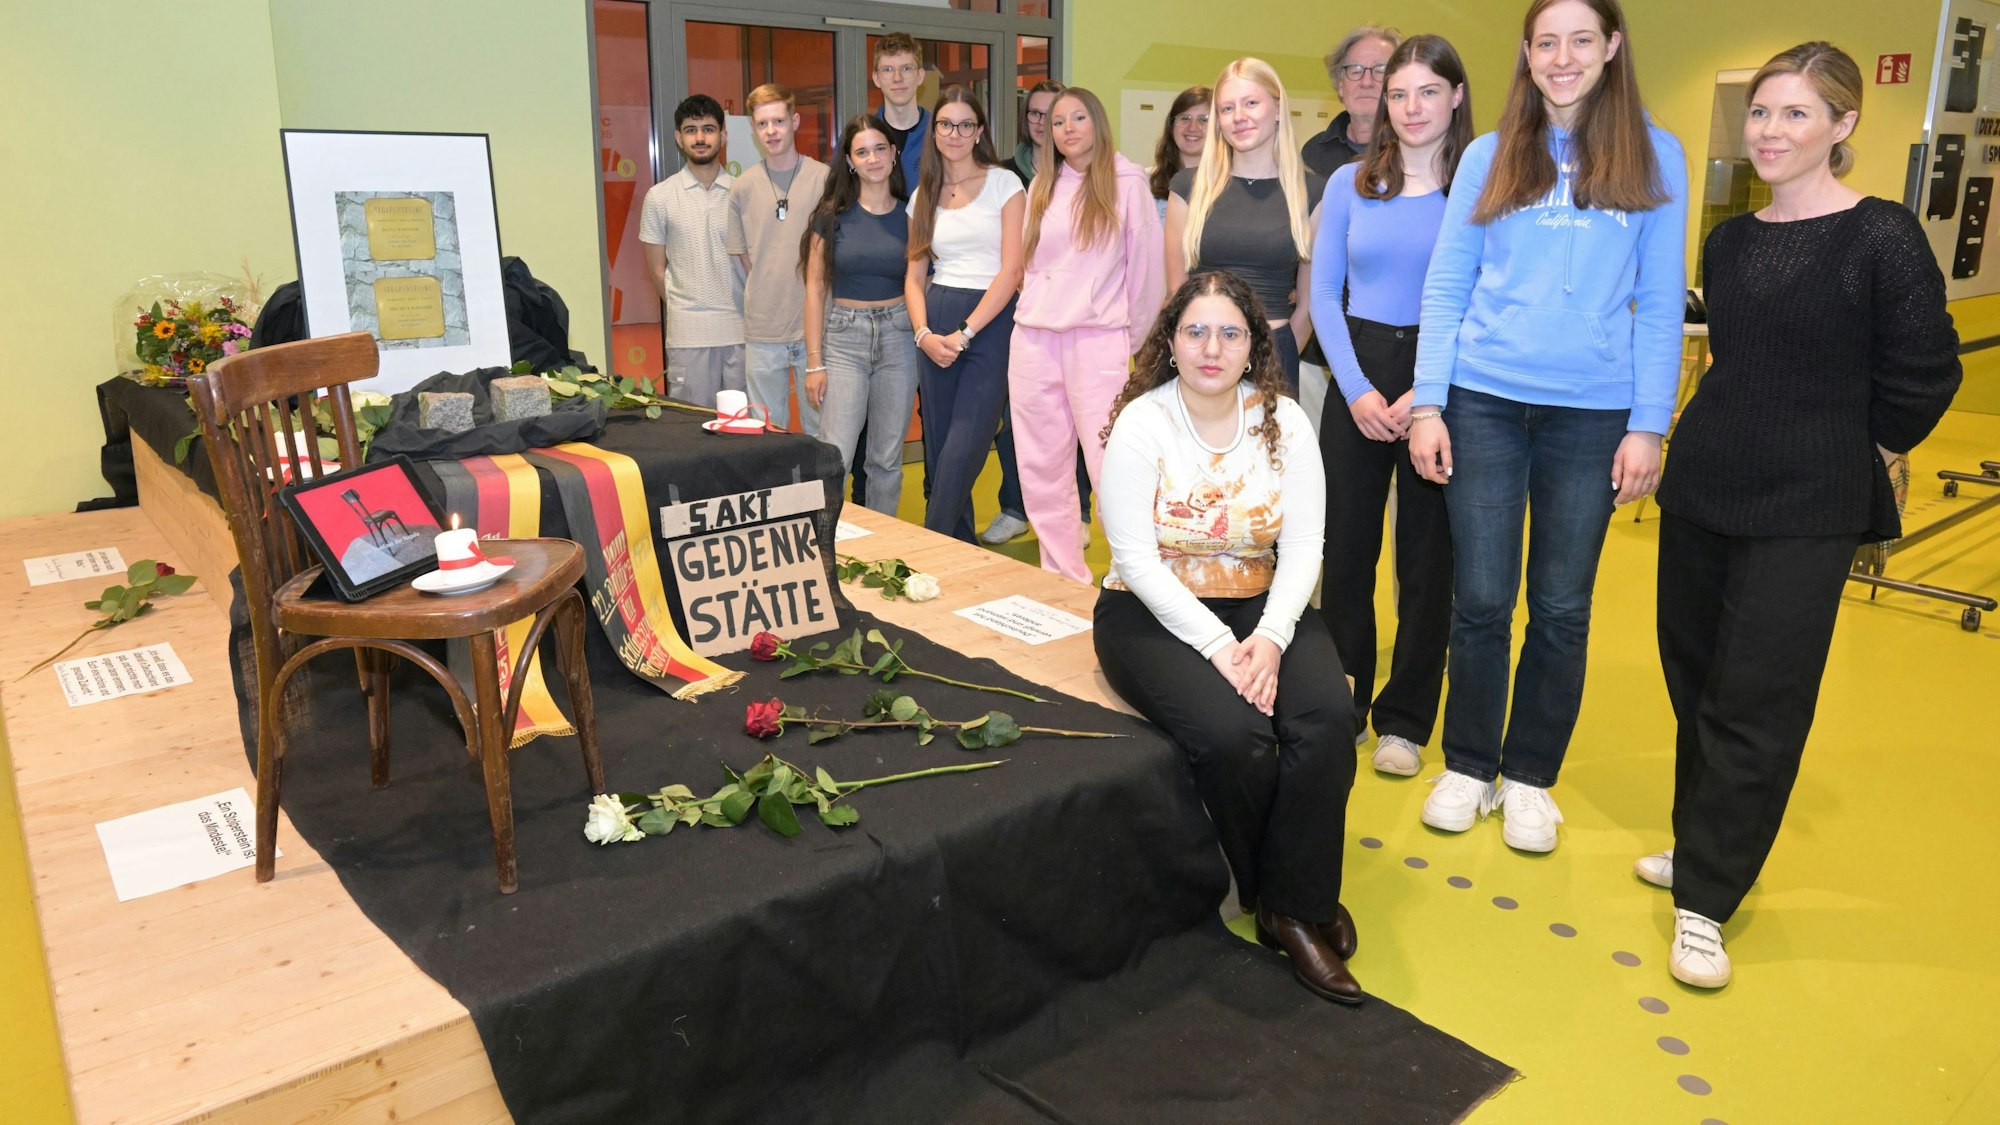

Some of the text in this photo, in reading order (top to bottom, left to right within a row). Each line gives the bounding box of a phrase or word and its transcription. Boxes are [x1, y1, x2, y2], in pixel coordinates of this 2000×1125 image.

[678, 522, 819, 582] GEDENK-
[689, 579, 824, 643] STÄTTE
[198, 812, 211, 823] das
[224, 812, 252, 849] Stolperstein
